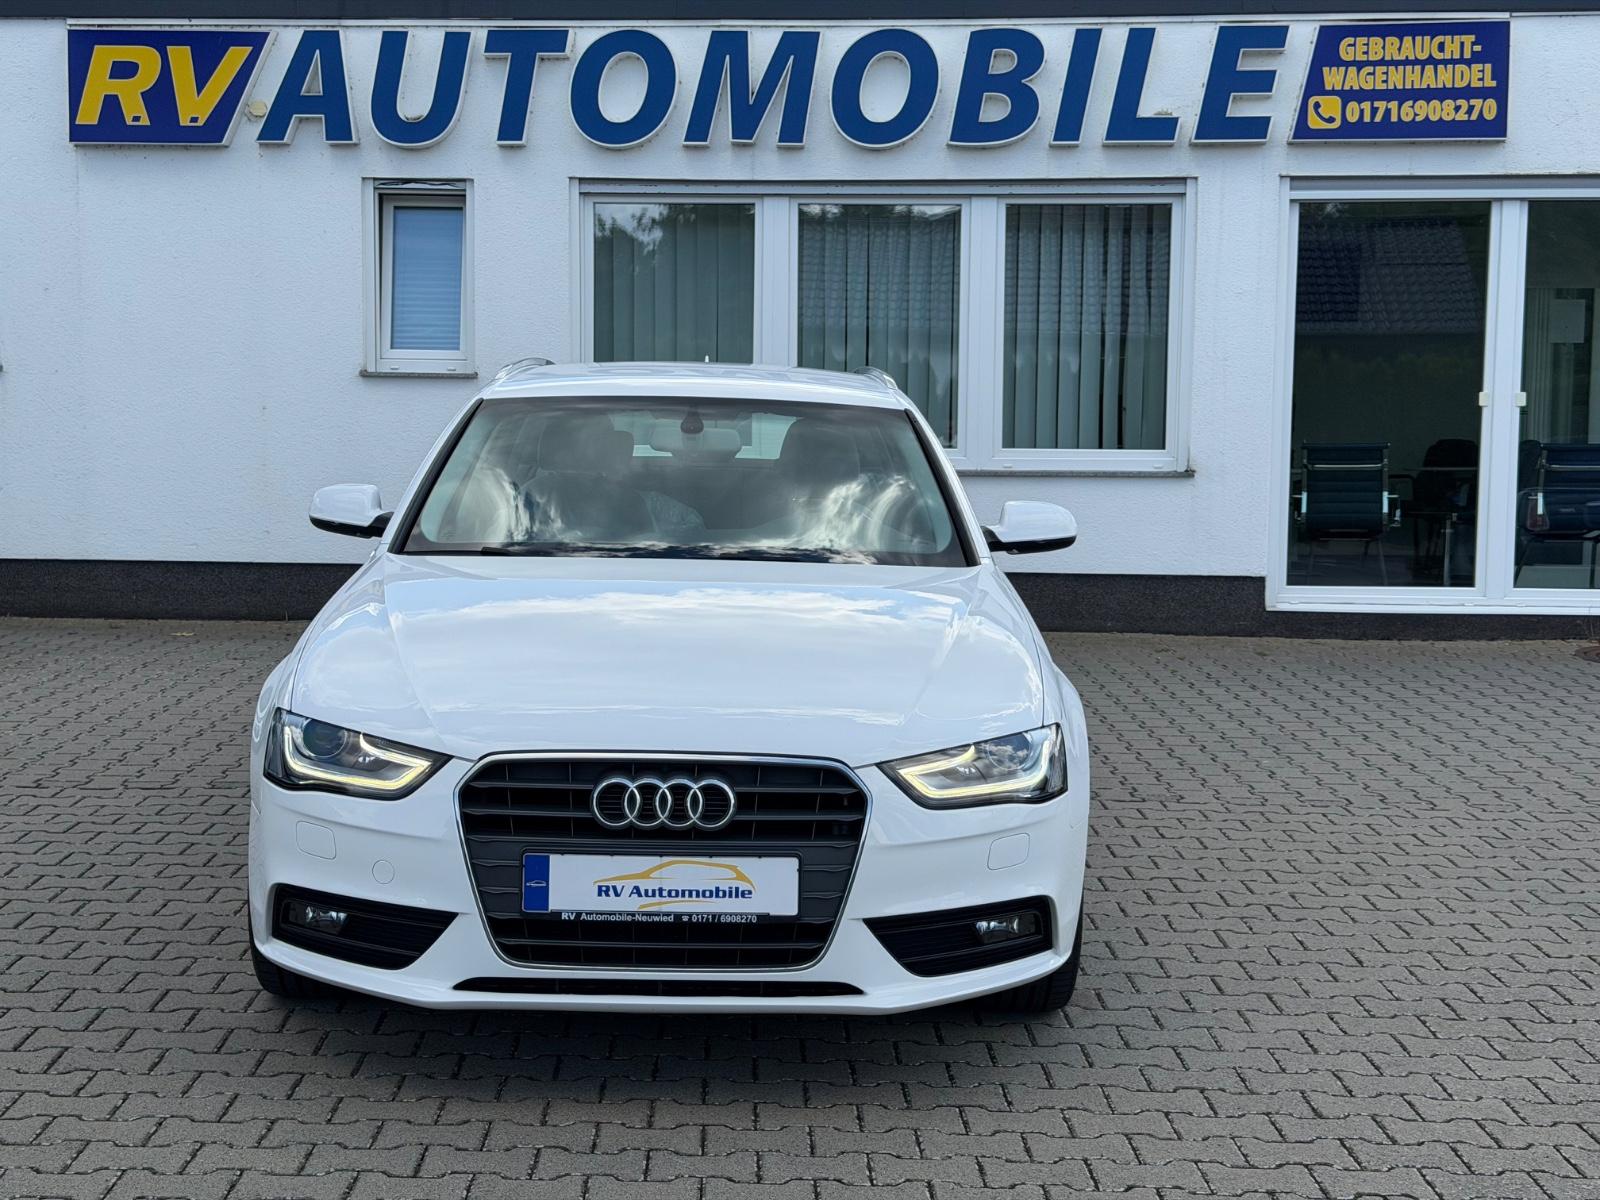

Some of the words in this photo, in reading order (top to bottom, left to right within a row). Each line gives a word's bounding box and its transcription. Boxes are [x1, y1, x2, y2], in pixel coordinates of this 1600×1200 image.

[1339, 35, 1482, 61] GEBRAUCHT-
[257, 26, 1289, 148] AUTOMOBILE
[1322, 64, 1497, 90] WAGENHANDEL
[1345, 98, 1498, 123] 01716908270
[597, 885, 625, 898] RV
[628, 885, 753, 899] Automobile
[561, 912, 576, 920] RV
[580, 912, 674, 922] Automobile-Neuwied
[691, 914, 712, 922] 0171
[720, 914, 757, 922] 6908270
